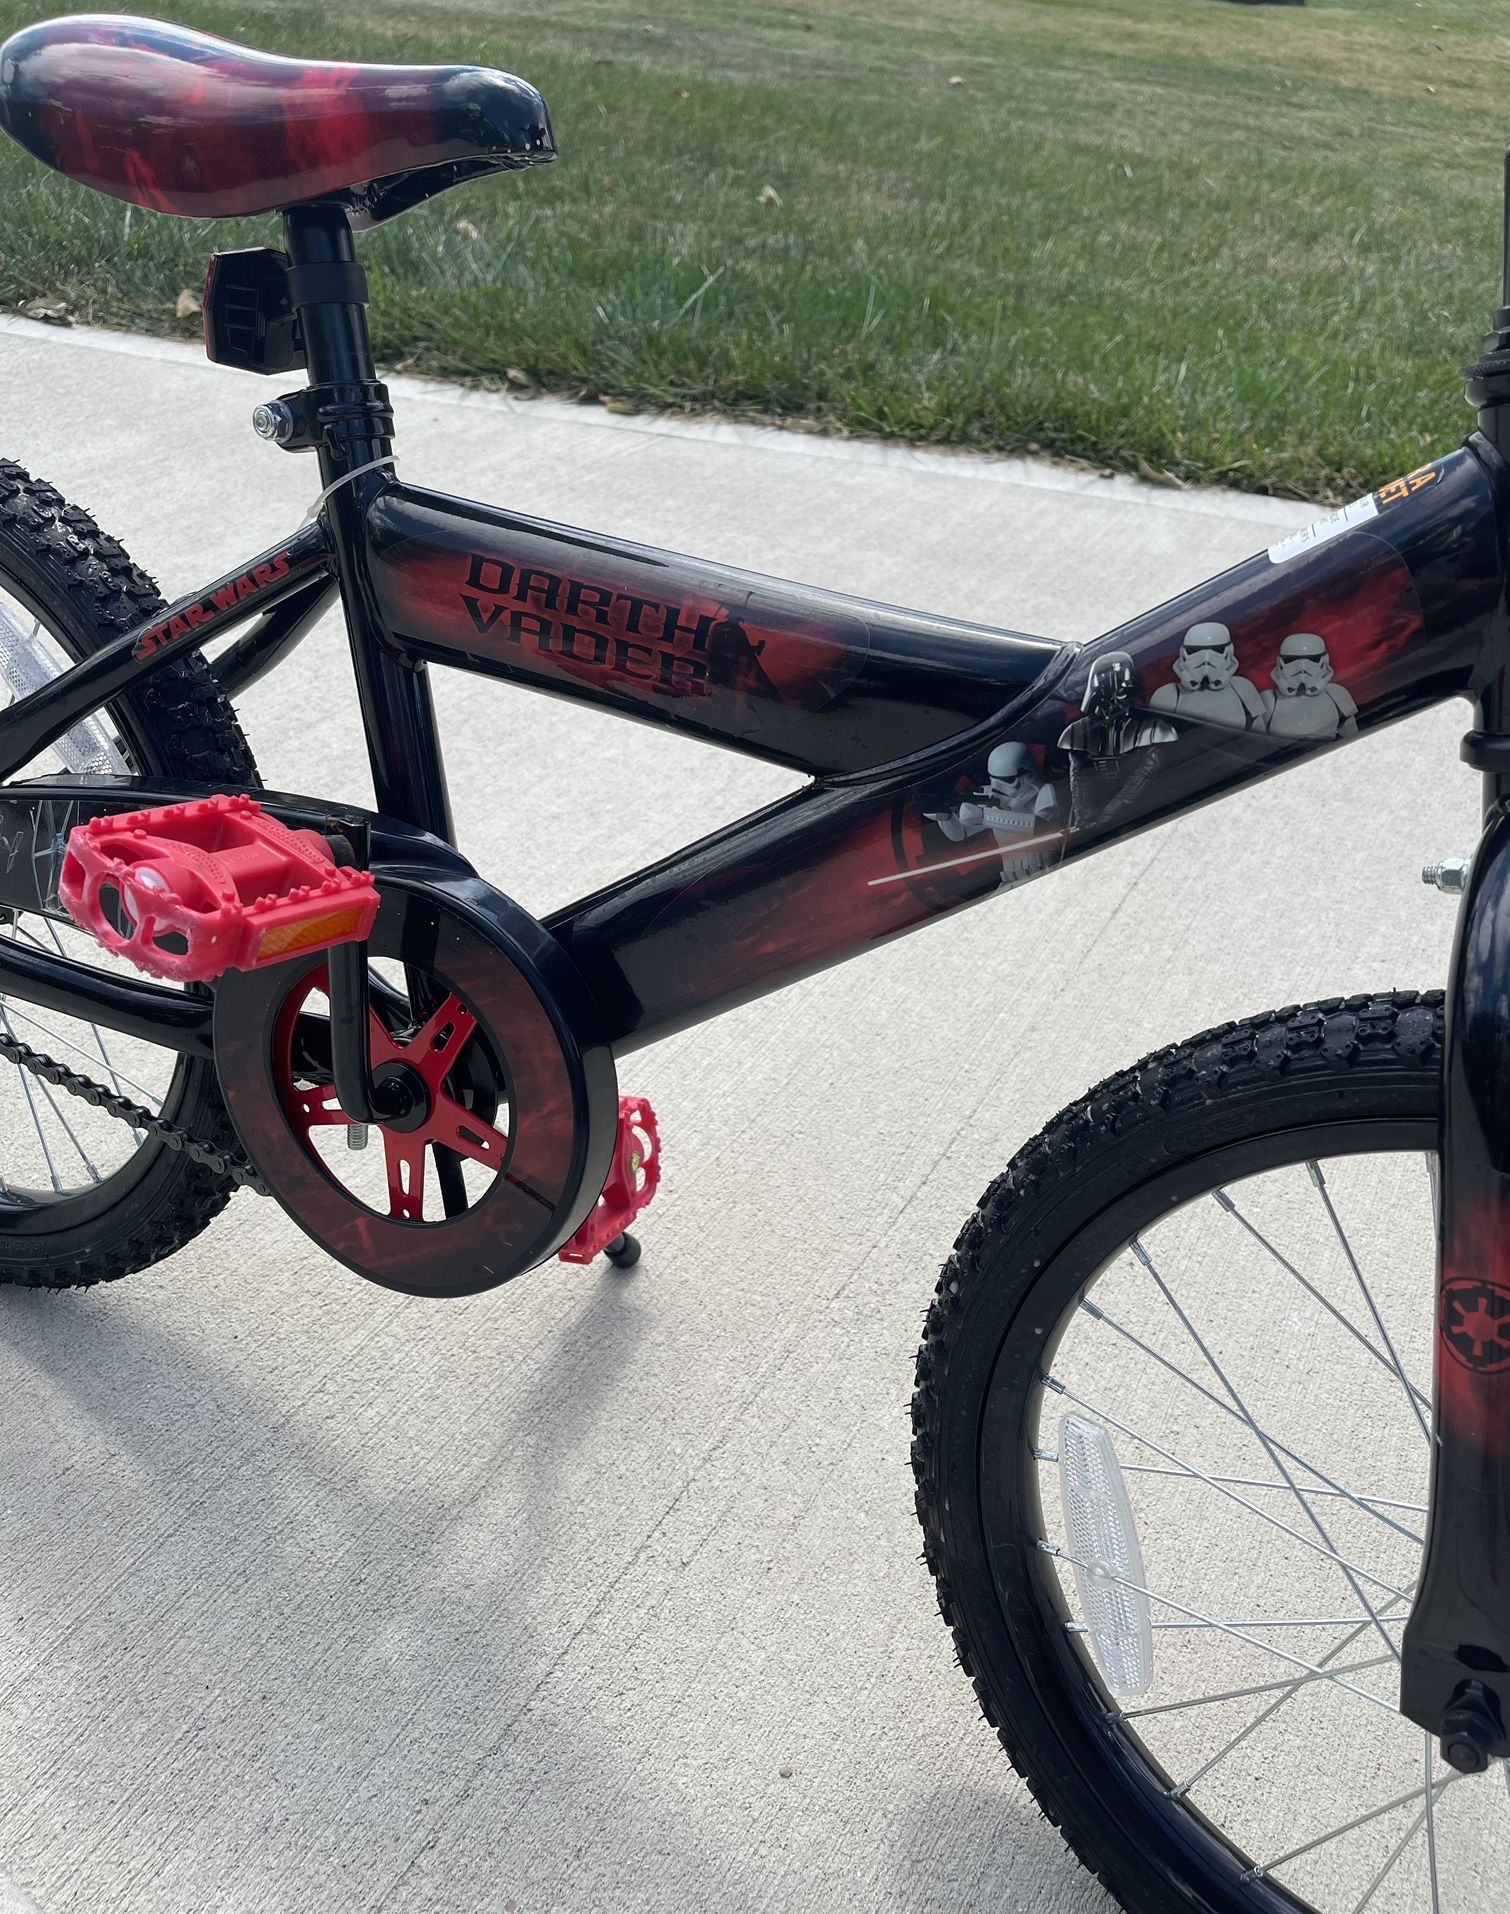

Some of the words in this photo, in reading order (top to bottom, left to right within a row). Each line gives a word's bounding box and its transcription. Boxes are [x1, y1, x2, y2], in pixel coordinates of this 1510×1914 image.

[134, 602, 216, 661] STAR
[209, 550, 290, 611] WARS
[458, 593, 713, 697] VADER
[464, 552, 719, 651] DARTH
